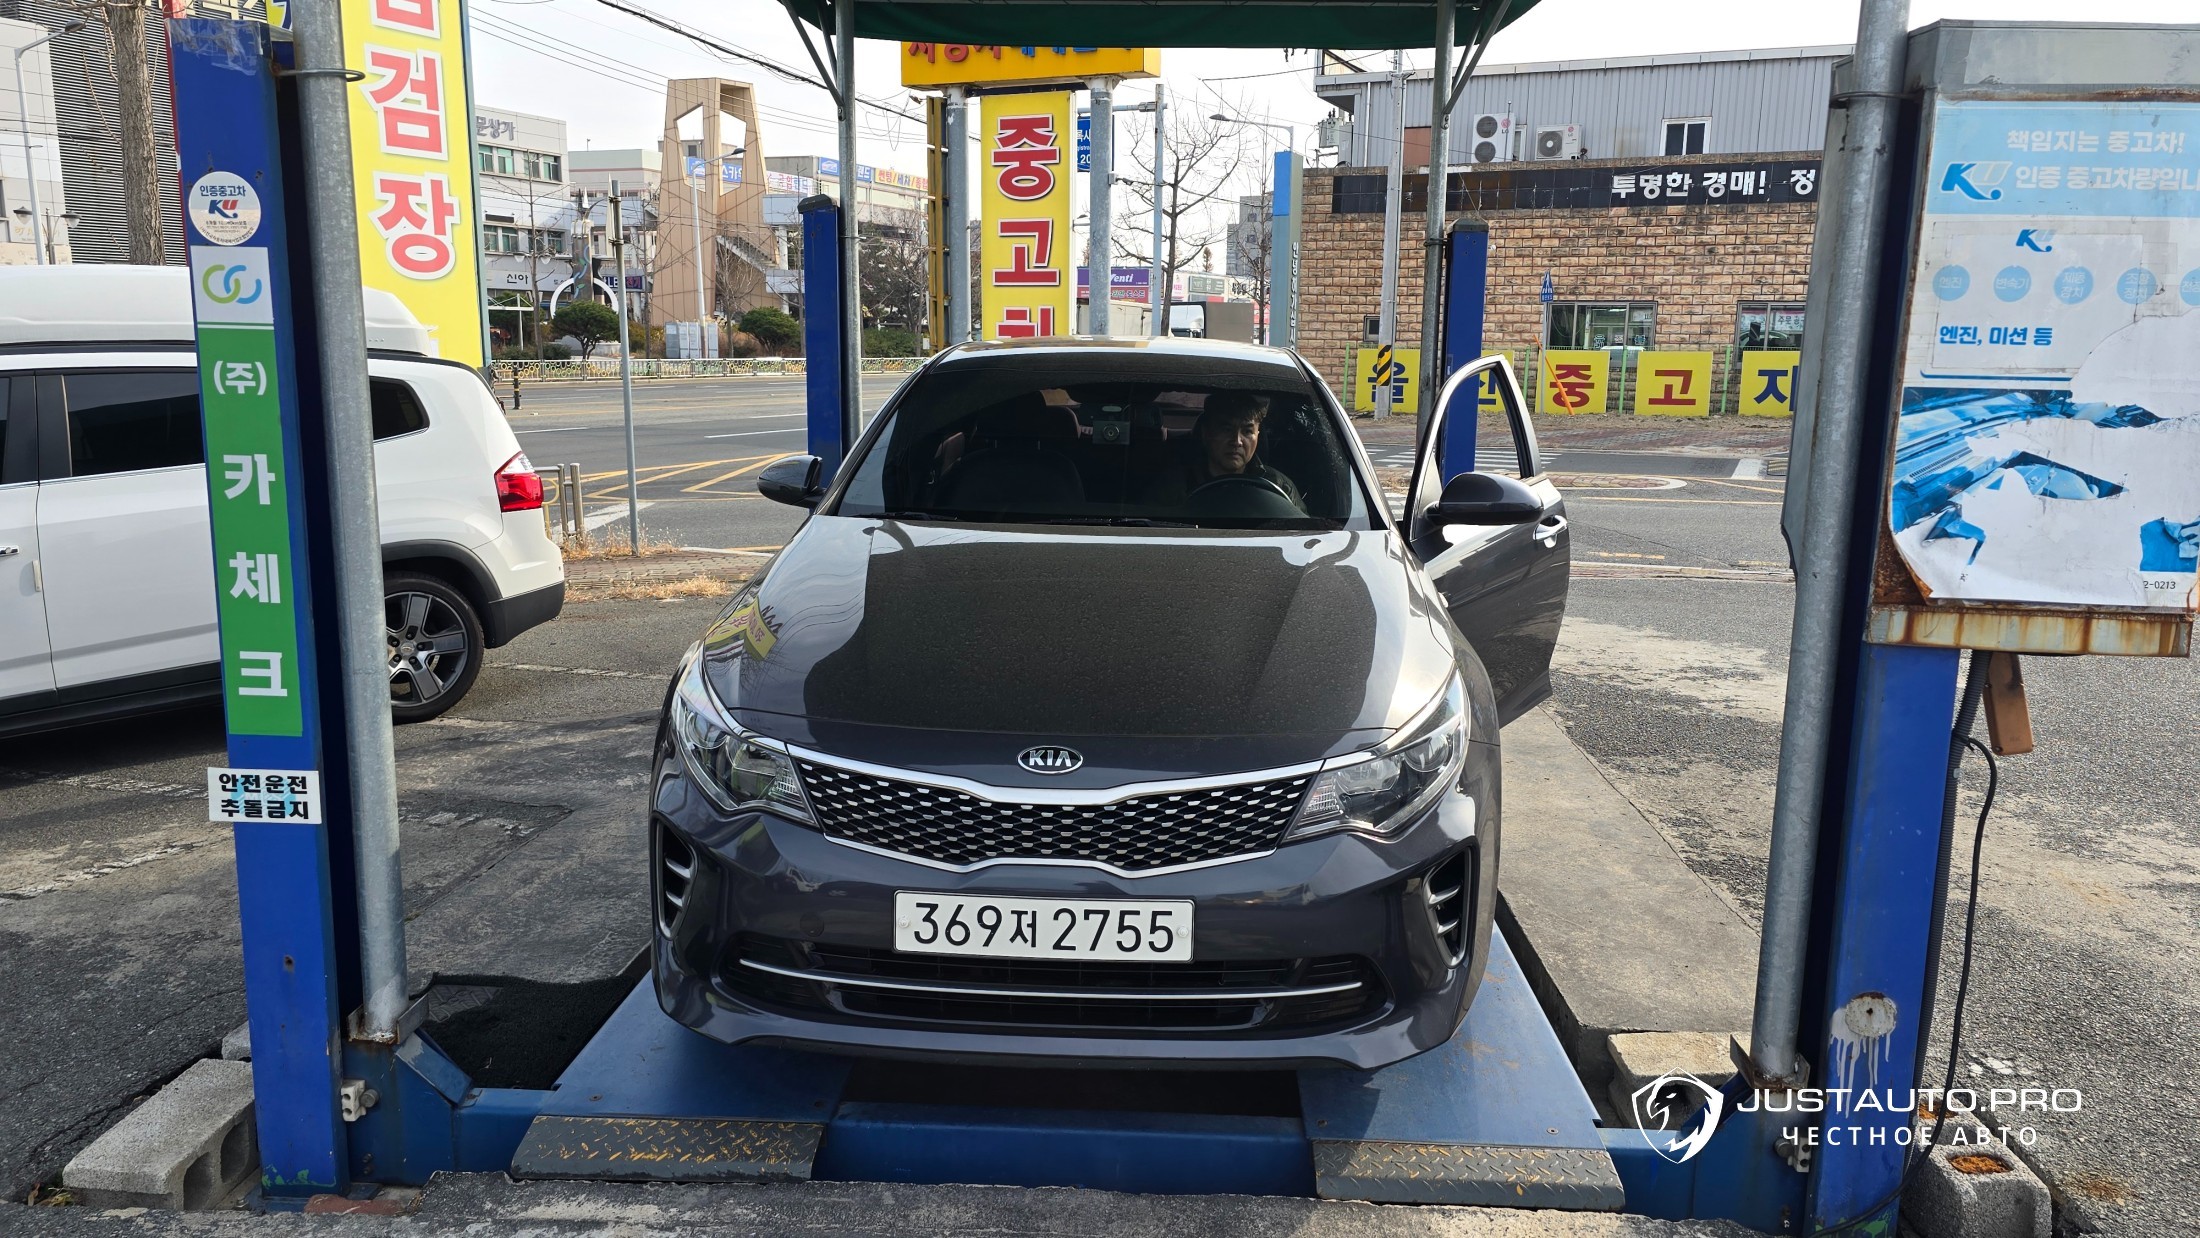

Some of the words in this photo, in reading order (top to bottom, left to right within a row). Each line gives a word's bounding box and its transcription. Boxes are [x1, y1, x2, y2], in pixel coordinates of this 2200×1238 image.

[2007, 129, 2099, 153] 책임지는
[2106, 131, 2185, 155] 중고차!
[1611, 170, 1692, 199] 투명한
[1702, 169, 1767, 198] 경매!
[1790, 168, 1816, 196] 정
[2015, 165, 2062, 189] 인증
[200, 185, 246, 198] 인증중고차
[1939, 326, 1982, 346] 엔진,
[1989, 326, 2027, 346] 미션
[2033, 327, 2053, 347] 등
[213, 360, 268, 396] (주)
[223, 452, 288, 698] 카체크
[1029, 749, 1072, 767] KIA
[218, 773, 309, 795] 안전운전
[221, 799, 310, 820] 추돌금지
[1052, 907, 1174, 953] 2755
